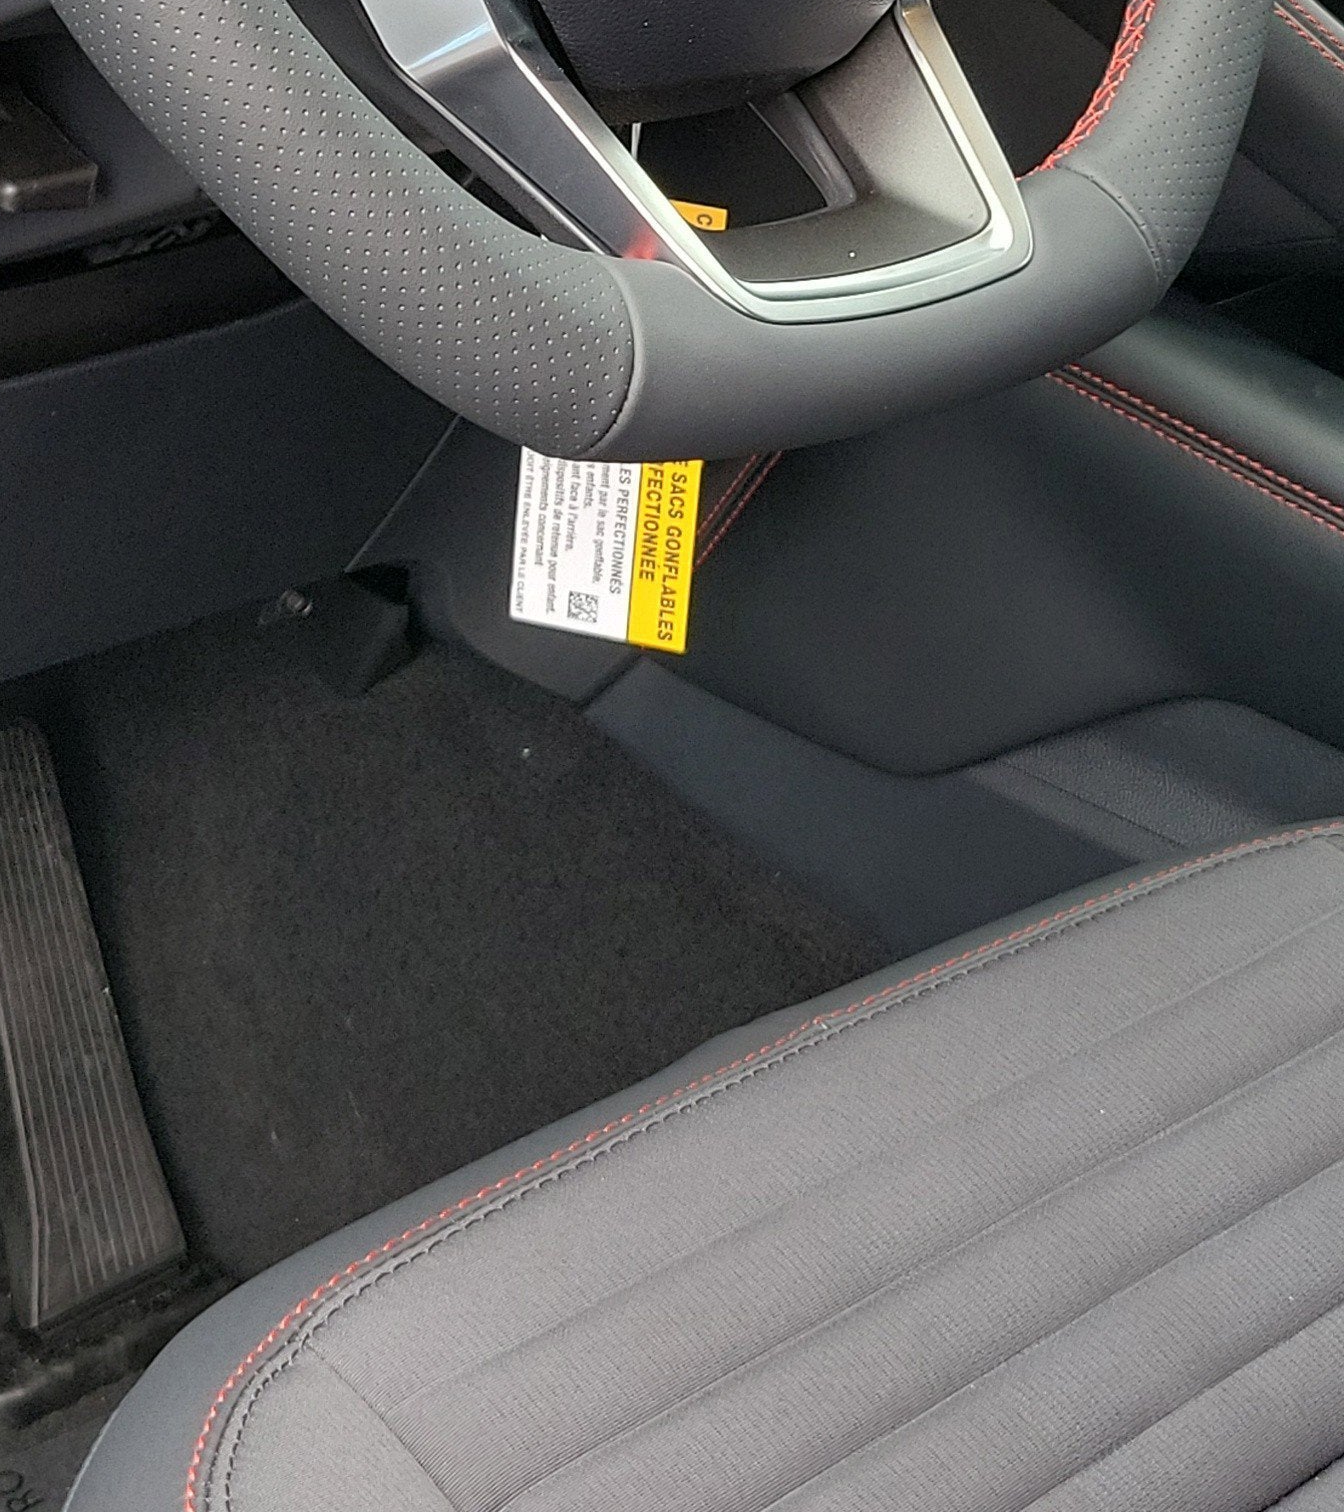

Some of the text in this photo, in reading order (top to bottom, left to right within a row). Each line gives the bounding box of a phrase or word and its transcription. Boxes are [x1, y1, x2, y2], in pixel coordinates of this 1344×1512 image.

[569, 482, 581, 502] face
[596, 521, 605, 536] sac
[609, 463, 632, 595] ES PERFECTIONNÉS
[639, 464, 664, 582] FECTIONNÉE
[667, 472, 688, 520] SACS
[657, 525, 683, 642] GONFLABLES
